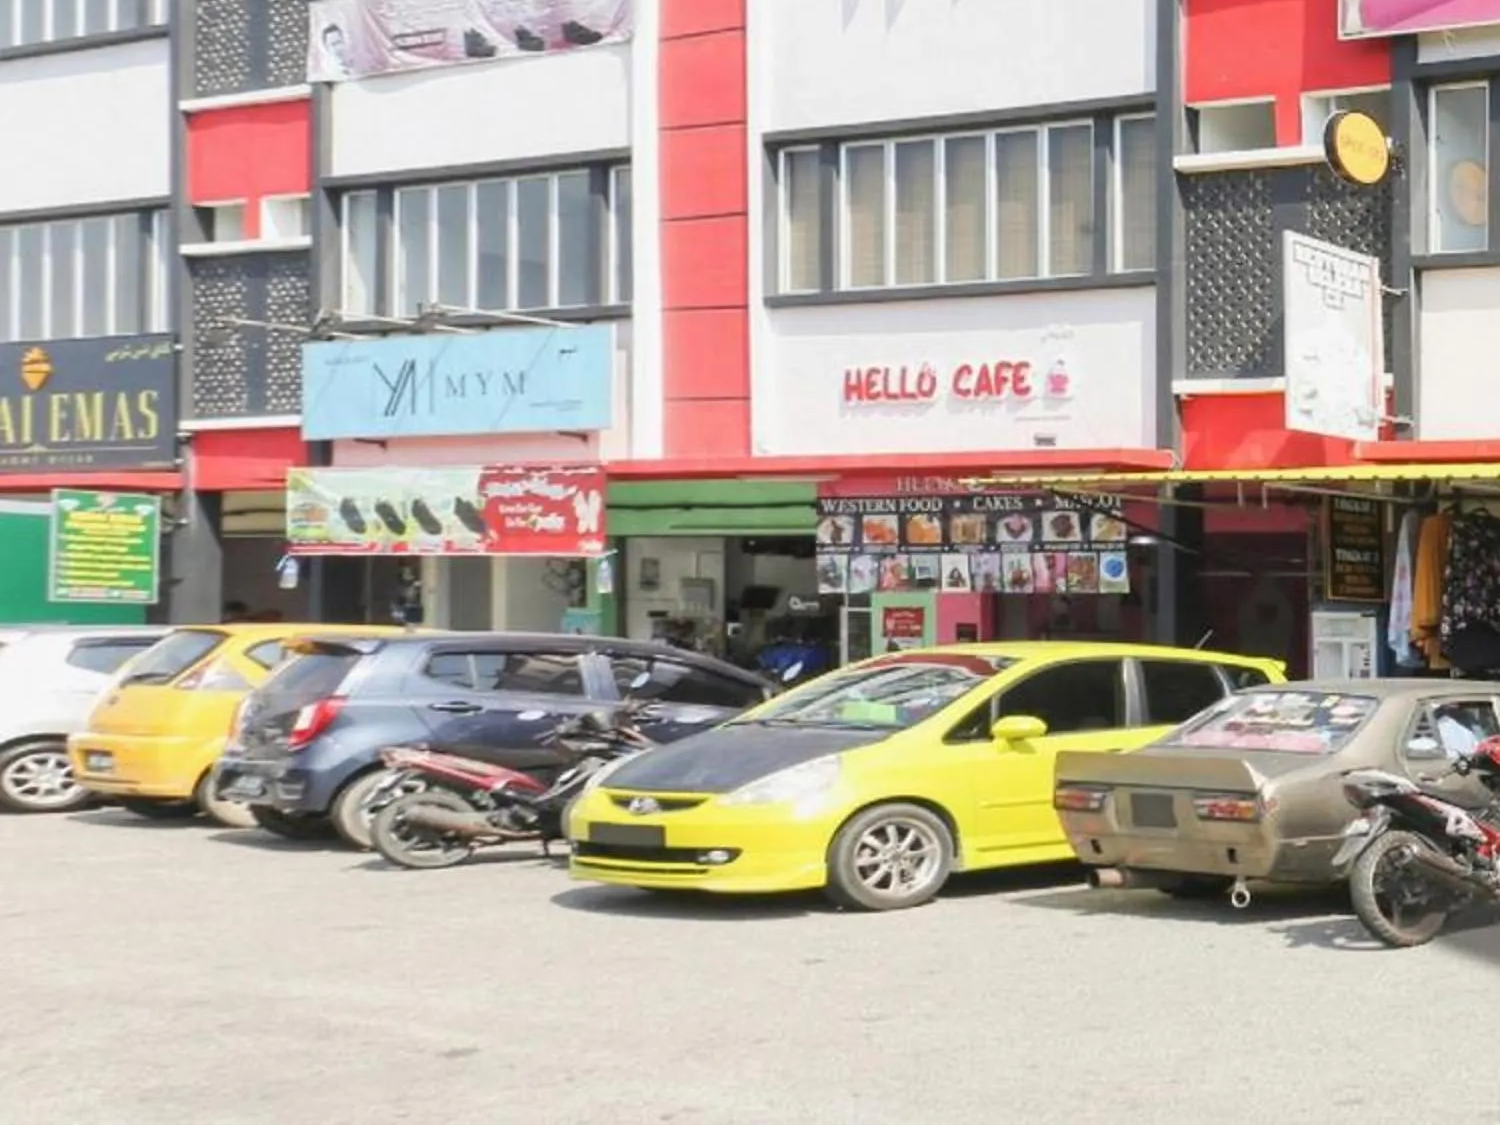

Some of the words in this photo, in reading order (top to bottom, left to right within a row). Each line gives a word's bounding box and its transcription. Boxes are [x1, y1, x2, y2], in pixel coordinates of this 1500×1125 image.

[844, 364, 937, 402] HELLO
[952, 360, 1032, 397] CAFE
[50, 389, 160, 443] EMAS
[820, 498, 897, 513] WESTERN
[899, 497, 943, 512] FOOD
[973, 496, 1024, 511] CAKES
